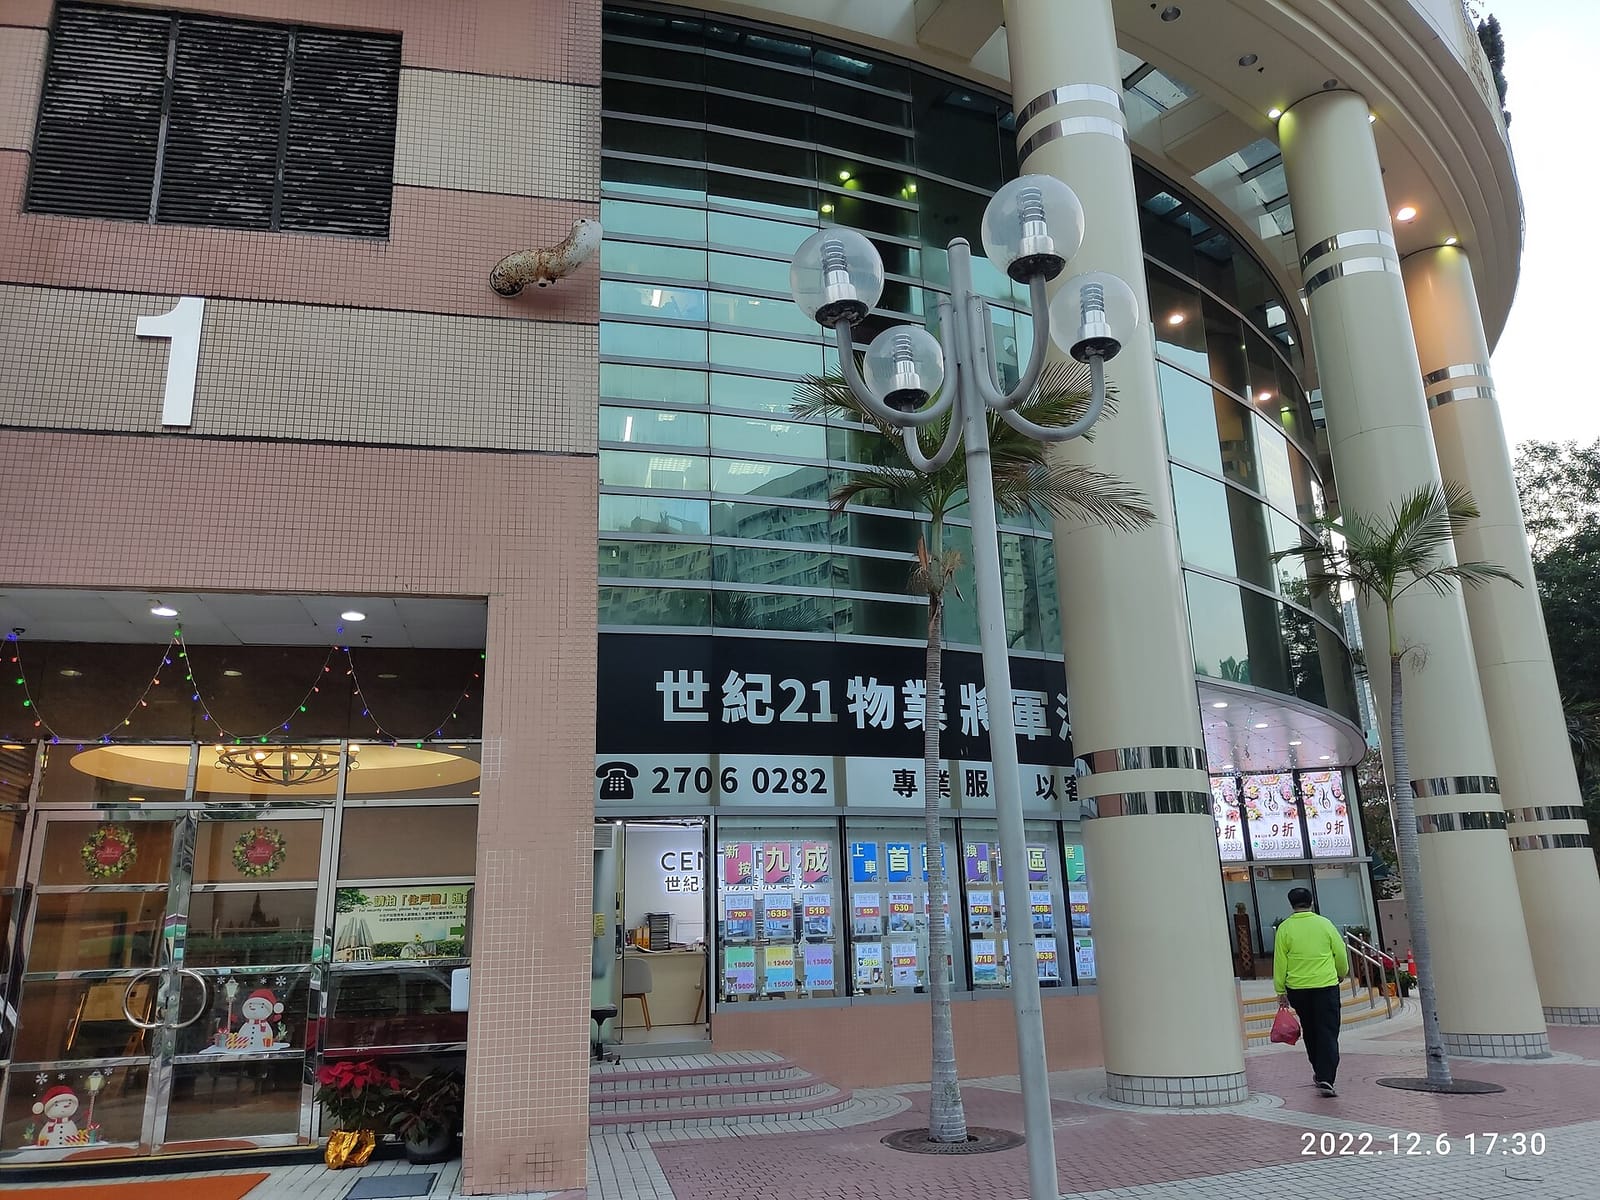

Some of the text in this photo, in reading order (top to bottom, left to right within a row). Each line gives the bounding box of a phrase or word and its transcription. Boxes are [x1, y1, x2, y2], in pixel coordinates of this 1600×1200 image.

[135, 297, 205, 428] 1
[752, 767, 828, 794] 0282
[808, 907, 825, 915] 518
[894, 904, 909, 912] 630
[770, 909, 787, 918] 638
